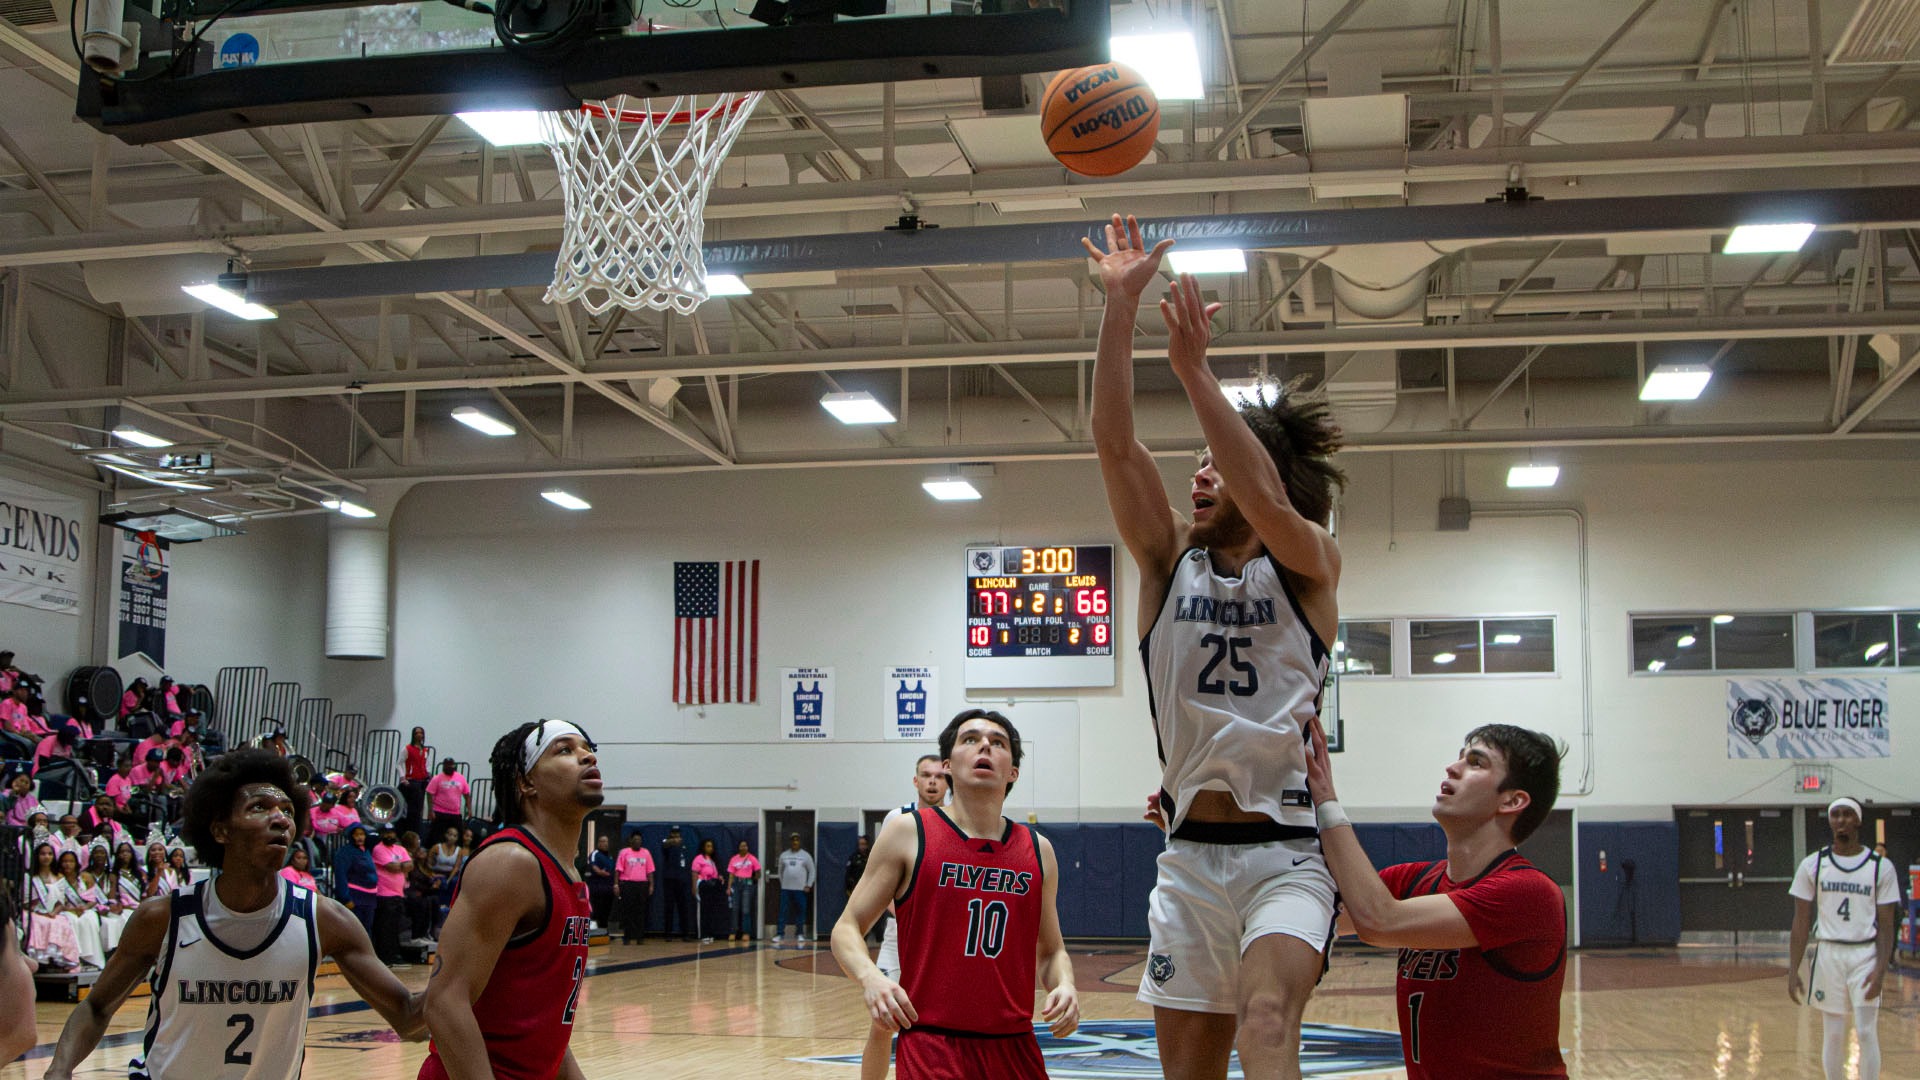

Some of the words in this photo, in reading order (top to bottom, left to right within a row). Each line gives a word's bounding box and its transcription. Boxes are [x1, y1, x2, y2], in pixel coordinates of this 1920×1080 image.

[1064, 67, 1119, 104] NCAA
[1071, 95, 1149, 138] Wilson
[1022, 548, 1073, 573] 3:00
[975, 577, 1017, 588] LINCOLN
[1029, 583, 1049, 591] GAME
[1065, 576, 1097, 586] LEWIS
[979, 591, 1009, 614] 77
[1032, 593, 1045, 613] 2
[1077, 589, 1107, 614] 66
[968, 618, 992, 626] FOULS
[1014, 617, 1041, 625] PLAYER
[1045, 616, 1064, 624] FOUL
[971, 627, 989, 645] 10
[1069, 629, 1080, 643] 2
[1095, 624, 1107, 644] 8
[968, 648, 992, 656] SCORE
[1025, 648, 1051, 656] MATCH
[1086, 647, 1110, 655] SCORE
[1198, 633, 1259, 696] 25
[802, 702, 814, 713] 24
[905, 701, 916, 712] 41
[1782, 699, 1827, 729] BLUE
[1832, 699, 1884, 729] TIGER
[938, 862, 1032, 896] FLYERS
[1820, 880, 1873, 896] LINCOLN
[1837, 897, 1850, 921] 4
[964, 898, 1009, 959] 10
[178, 979, 300, 1004] LINCOLN
[1408, 991, 1424, 1064] 1
[224, 1013, 255, 1065] 2
